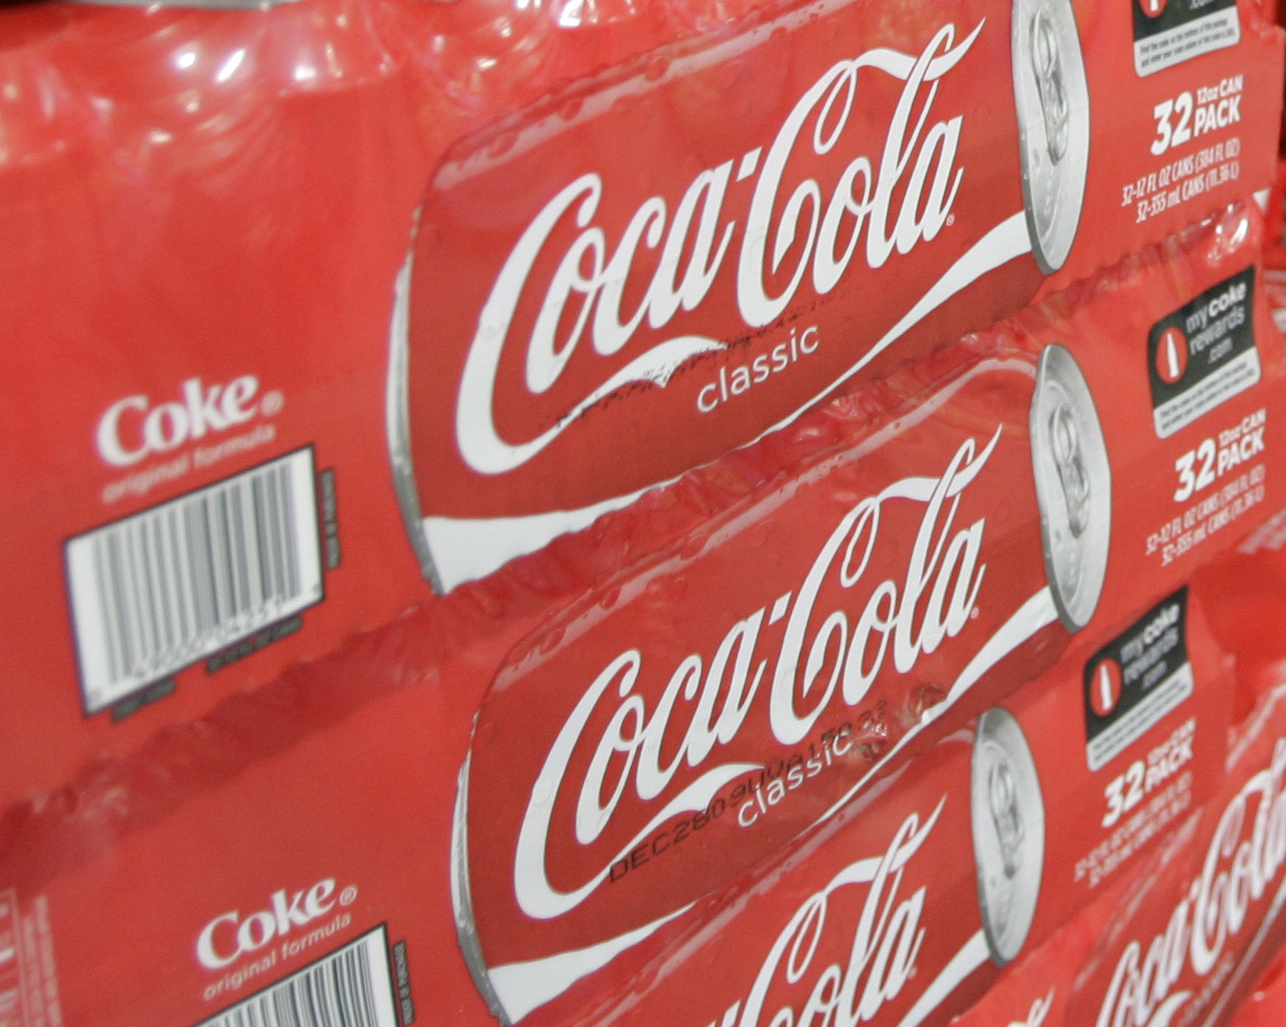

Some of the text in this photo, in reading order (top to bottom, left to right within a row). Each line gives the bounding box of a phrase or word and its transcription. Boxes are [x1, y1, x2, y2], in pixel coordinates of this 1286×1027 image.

[1150, 90, 1242, 156] 32 PACK
[1219, 74, 1244, 98] CAN
[1172, 154, 1195, 182] CANS
[1182, 174, 1205, 201] CANS
[455, 17, 986, 474] Coca-Cola
[696, 325, 820, 413] classic
[1189, 305, 1246, 356] rewards
[95, 373, 259, 468] Coke
[193, 423, 277, 470] formula
[1173, 425, 1266, 503] 32 PACK
[512, 424, 1002, 920] Coca-Cola
[737, 730, 855, 828] classic
[1101, 760, 1146, 829] 32
[195, 876, 337, 970] Coke
[202, 911, 352, 1003] original formula
